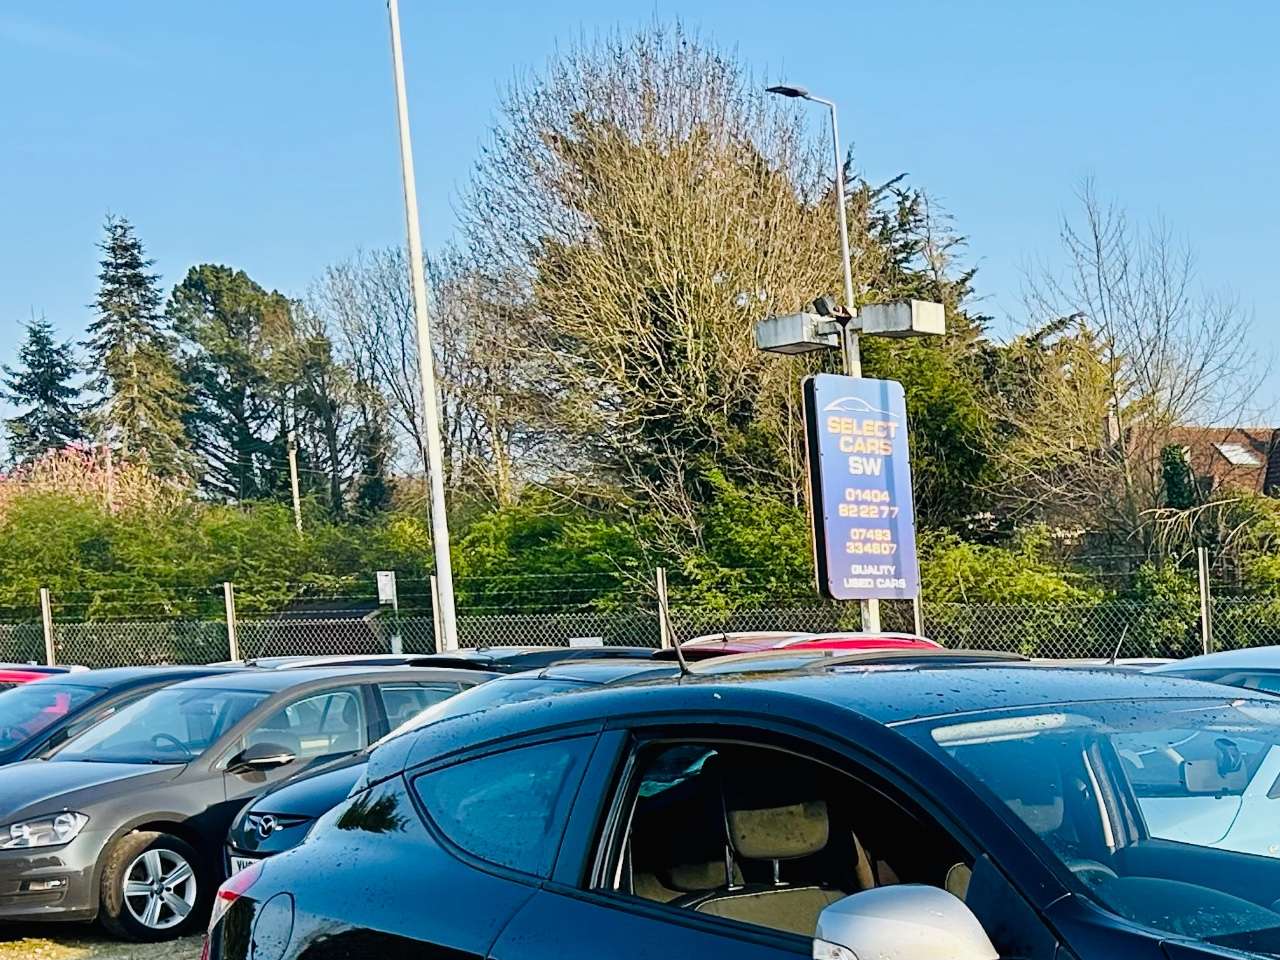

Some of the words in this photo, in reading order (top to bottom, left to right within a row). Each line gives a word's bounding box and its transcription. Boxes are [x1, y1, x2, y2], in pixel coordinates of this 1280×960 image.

[827, 416, 898, 439] SELECT
[840, 435, 892, 455] CARS
[848, 455, 882, 476] SW
[845, 487, 891, 503] 01404
[880, 505, 900, 519] 77
[851, 564, 896, 576] QUALITY
[843, 577, 875, 588] USED
[876, 577, 906, 589] CARS
